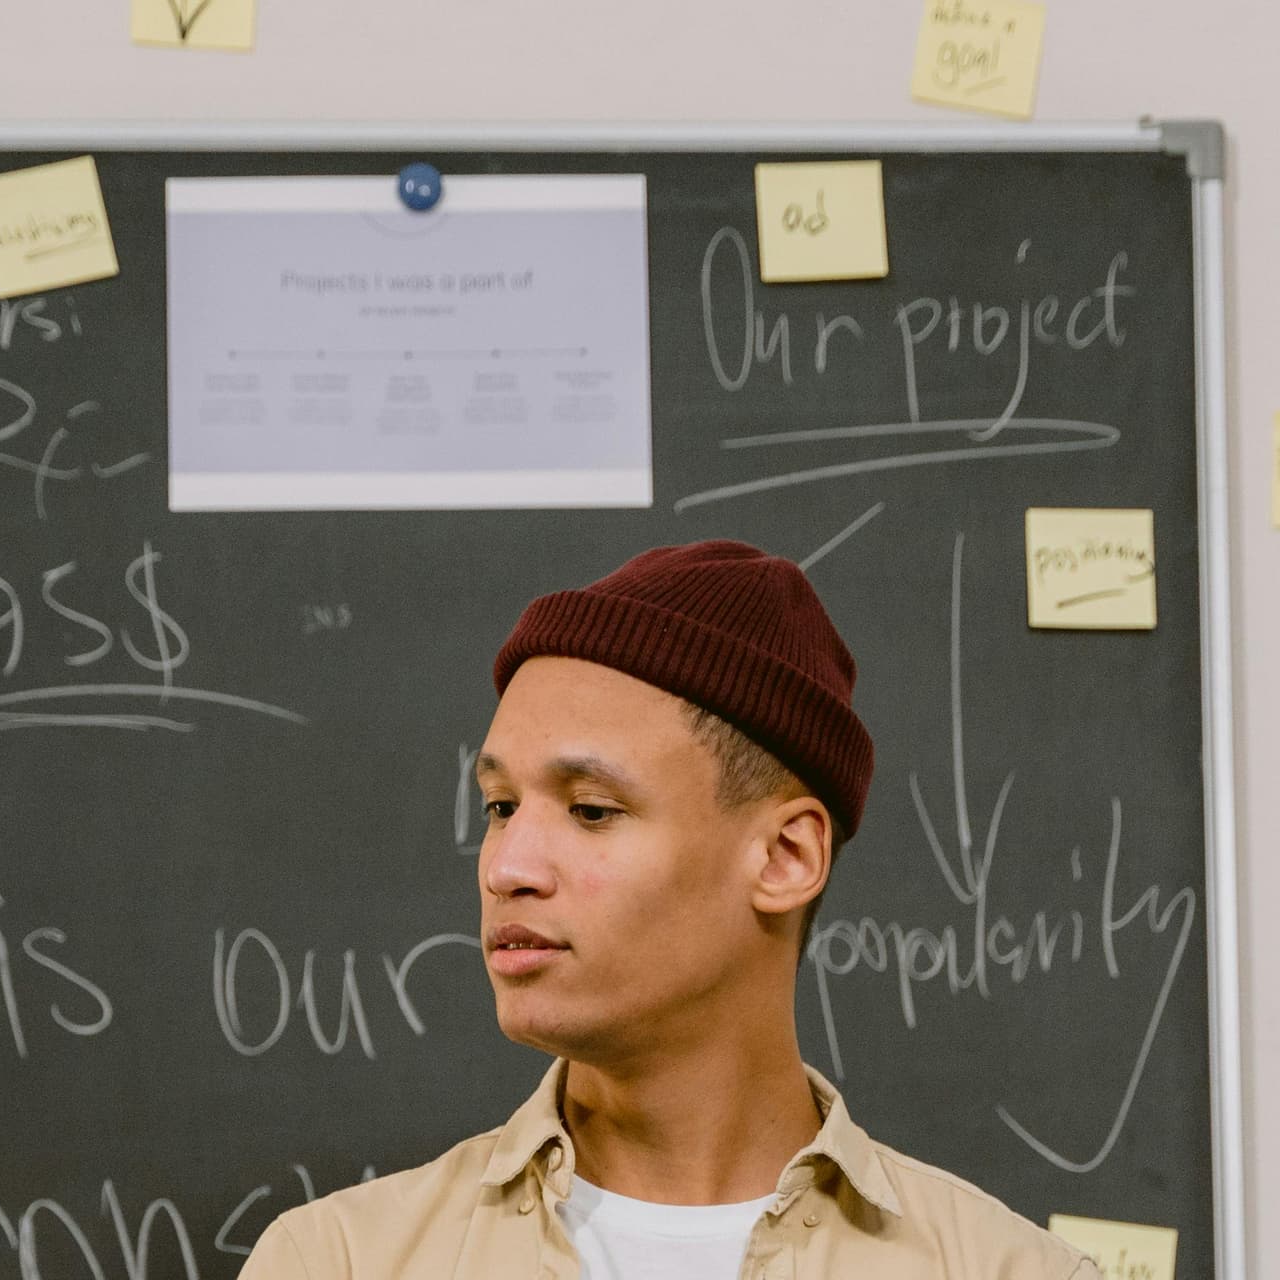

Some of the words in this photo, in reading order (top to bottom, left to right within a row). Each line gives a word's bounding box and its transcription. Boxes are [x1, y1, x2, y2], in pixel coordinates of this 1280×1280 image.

[781, 188, 831, 237] ad
[701, 226, 864, 392] Our
[893, 237, 1137, 441] project
[212, 927, 483, 1059] our
